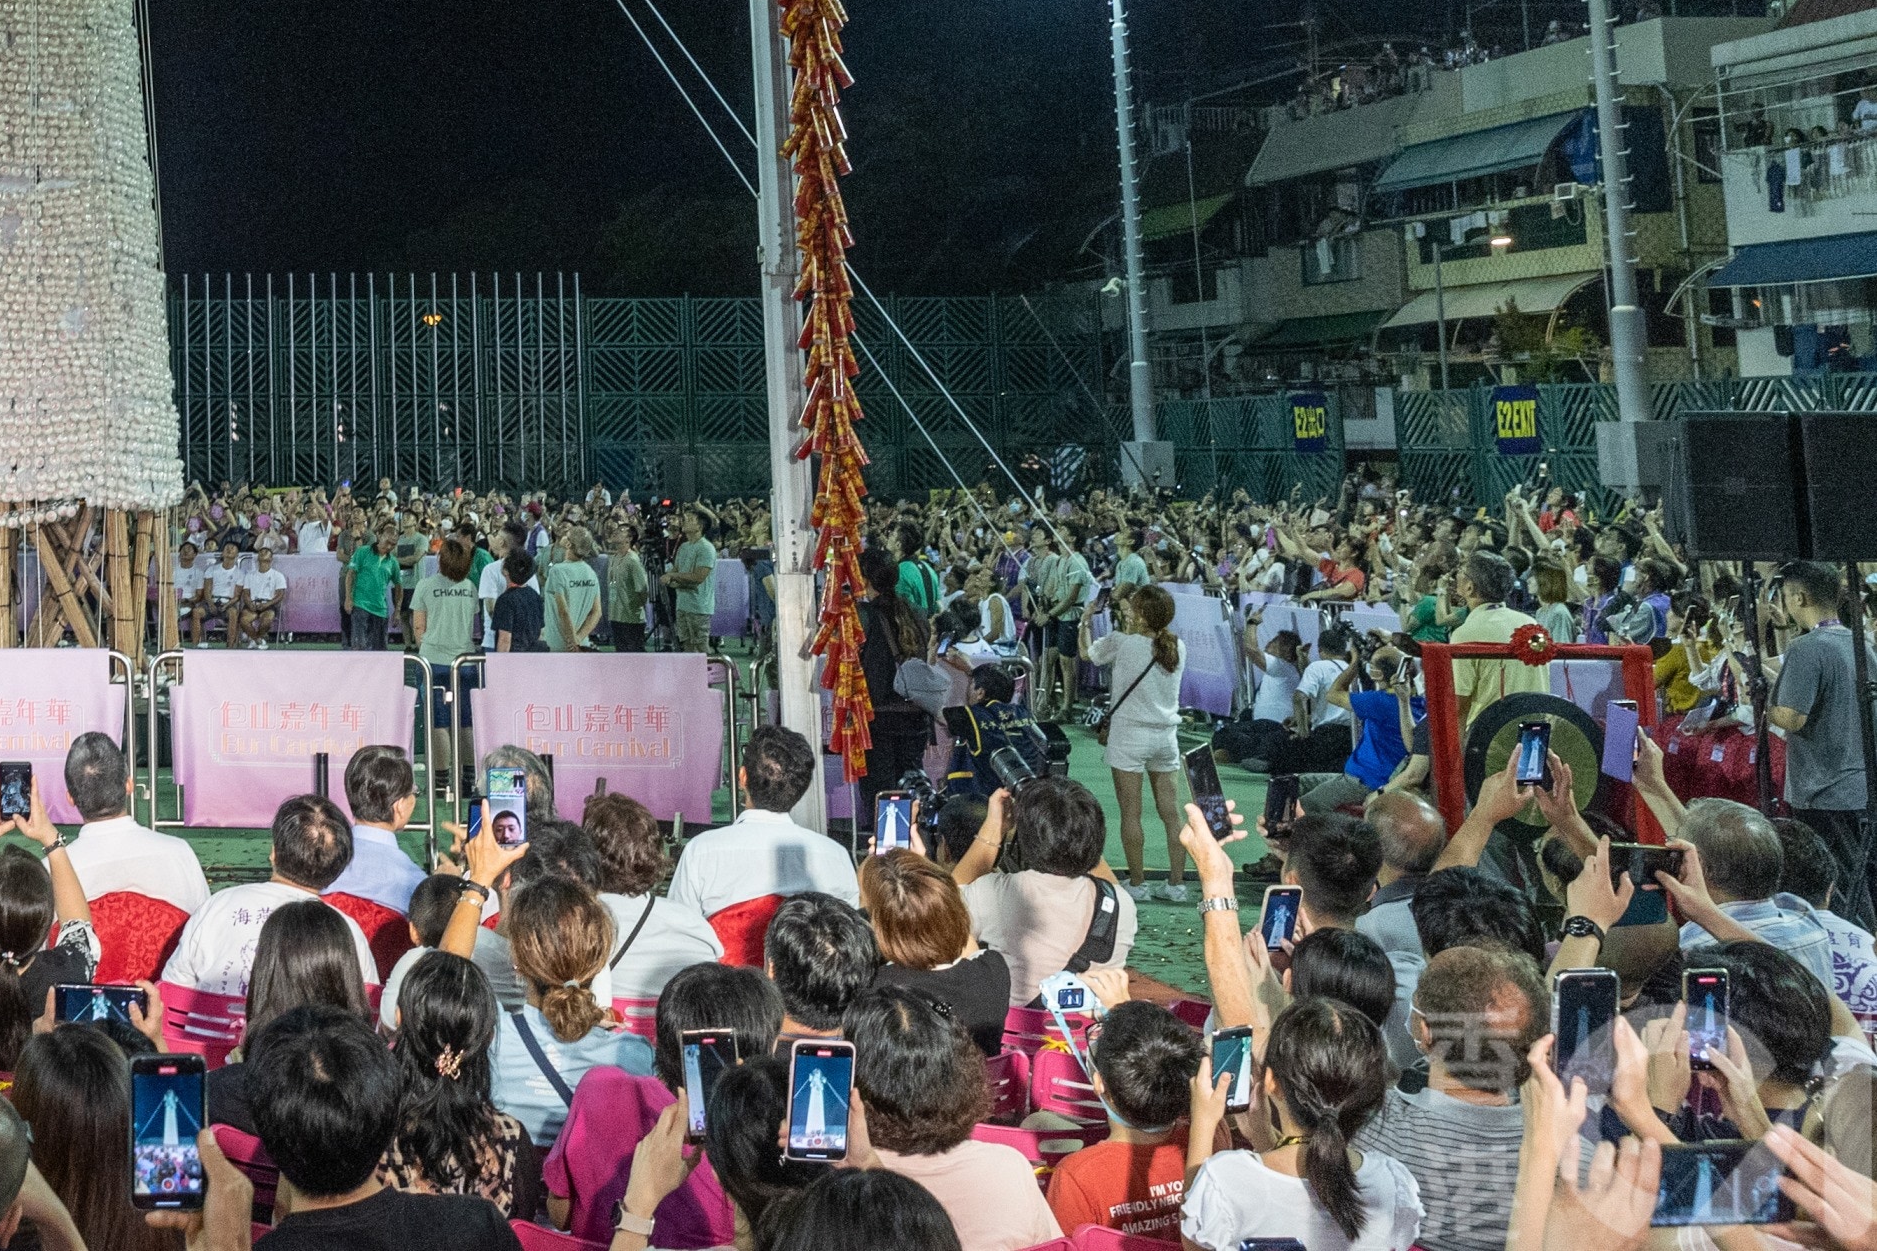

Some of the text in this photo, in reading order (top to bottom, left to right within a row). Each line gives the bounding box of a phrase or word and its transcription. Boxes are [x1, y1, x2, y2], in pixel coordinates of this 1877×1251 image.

[1496, 399, 1536, 438] E2 EXIT
[221, 701, 366, 732] 包山嘉年華
[524, 704, 670, 733] 包山嘉年華
[576, 736, 669, 759] Carnival
[1149, 1179, 1185, 1198] I'M YO
[1109, 1198, 1159, 1219] FRIENDLY
